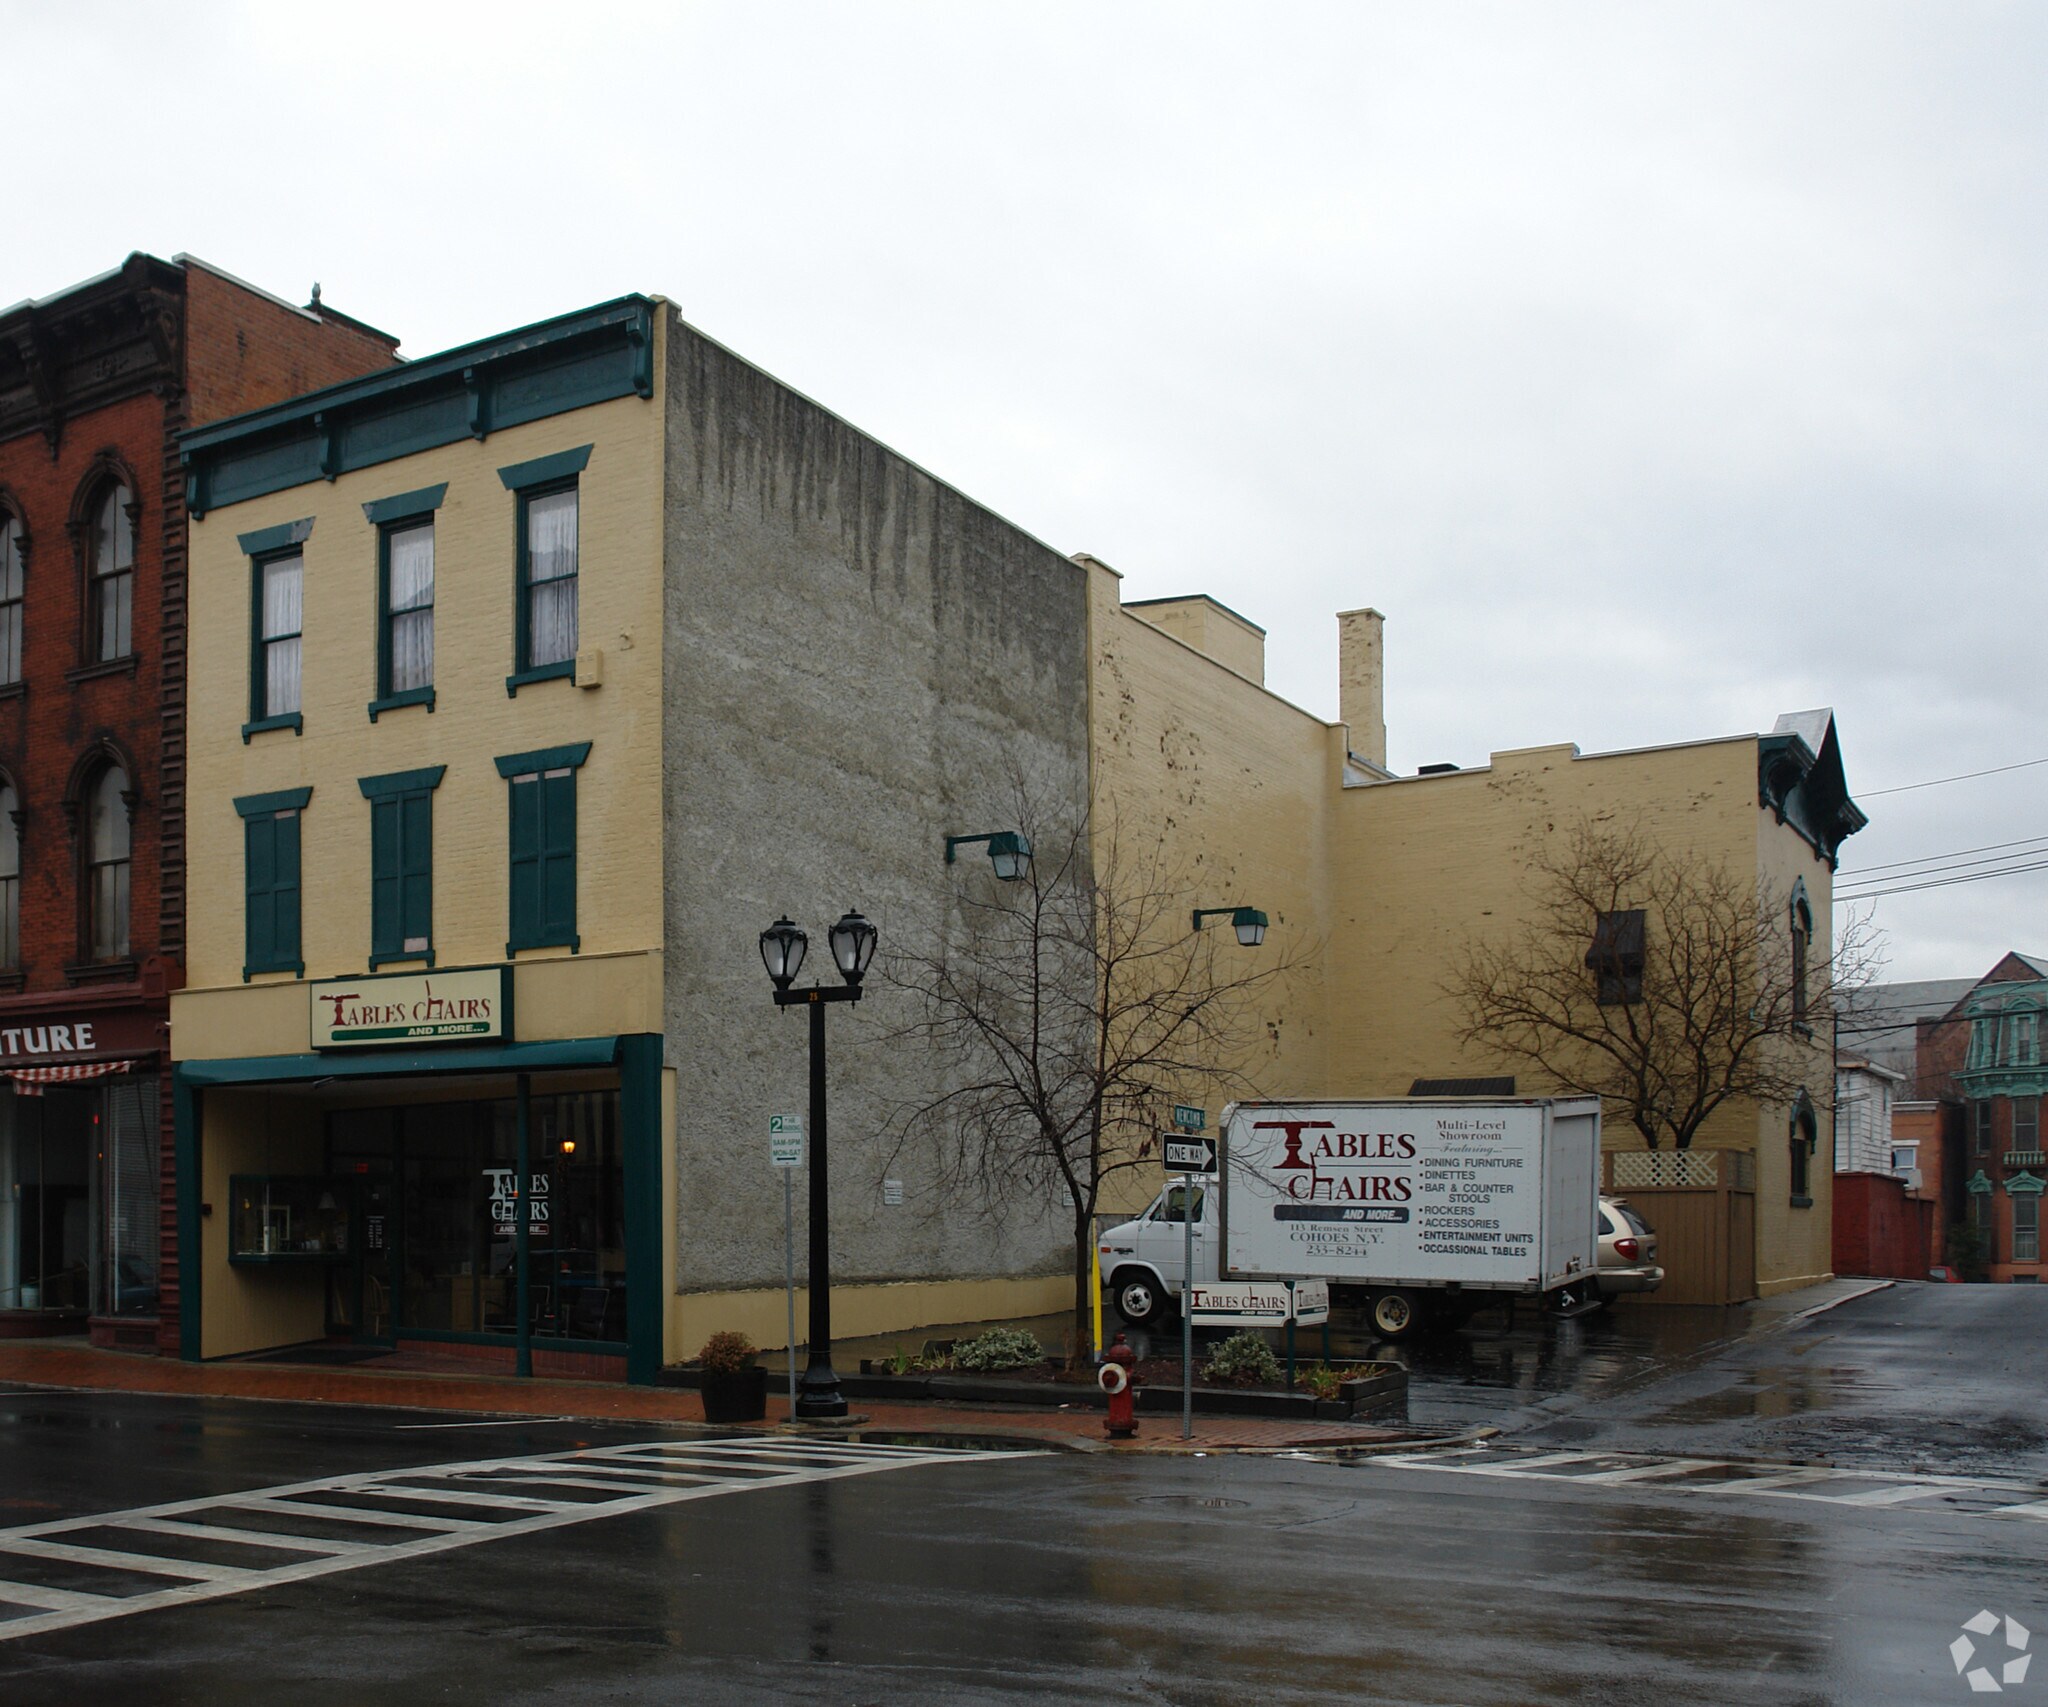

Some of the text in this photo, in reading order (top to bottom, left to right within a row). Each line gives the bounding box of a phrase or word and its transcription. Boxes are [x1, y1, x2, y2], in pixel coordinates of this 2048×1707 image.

[319, 994, 405, 1027] TABLES
[408, 1024, 485, 1036] AND MORE...
[0, 1023, 96, 1055] TURE
[772, 1117, 782, 1131] 2
[1436, 1120, 1506, 1130] Multi-Level
[1439, 1131, 1502, 1141] Showroom
[1252, 1121, 1417, 1169] TABLES
[1168, 1146, 1204, 1161] ONE WAY
[1424, 1158, 1523, 1168] DINING FURNITURE
[1288, 1152, 1412, 1201] CHAIRS
[1424, 1170, 1476, 1180] DINETTES
[482, 1168, 549, 1200] TAES
[1424, 1183, 1514, 1194] BAR & COUNTER
[1449, 1193, 1491, 1203] STOOLS
[1343, 1209, 1403, 1221] AND MORE...
[1424, 1205, 1475, 1215] ROCKERS
[500, 1225, 516, 1233] AND
[1354, 1225, 1385, 1234] Street
[1424, 1218, 1500, 1229] ACCESSORIES
[1290, 1232, 1385, 1244] COHOES N.Y.
[1423, 1230, 1534, 1244] ENTERTAINMENT UNITS
[1423, 1243, 1527, 1257] OCCASSIONAL TABLES
[1191, 1290, 1238, 1308] TABLES
